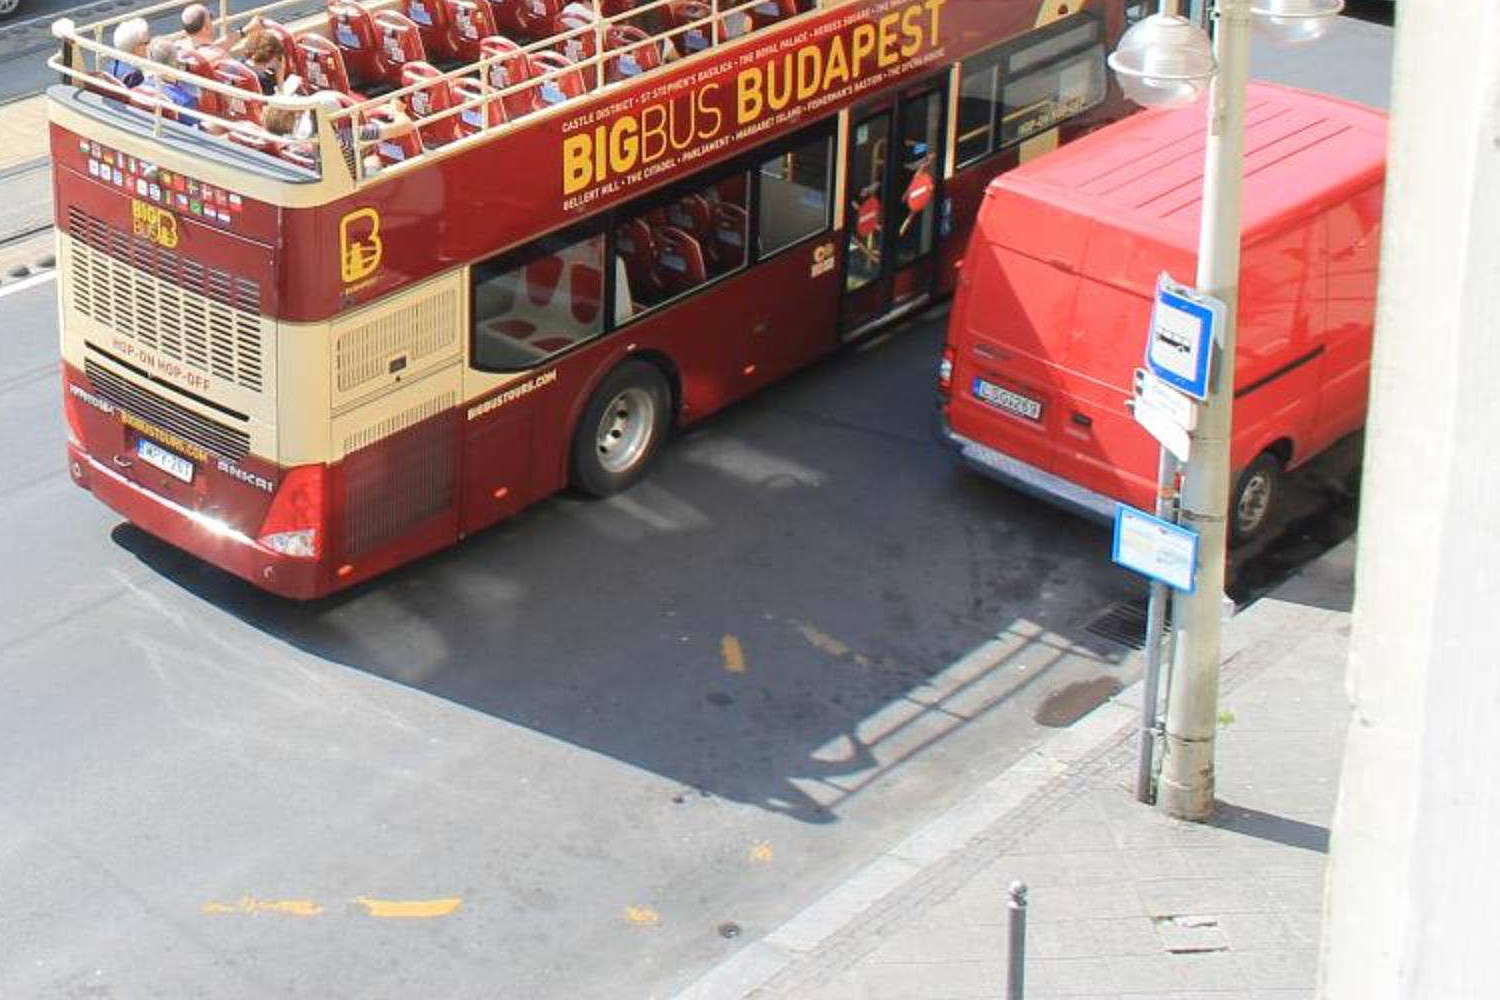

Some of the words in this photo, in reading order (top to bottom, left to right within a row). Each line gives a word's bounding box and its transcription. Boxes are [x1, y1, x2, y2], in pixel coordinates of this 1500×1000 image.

[562, 114, 595, 133] CASTLE
[596, 97, 633, 120] DISTRICT
[697, 61, 732, 82] BASILICA
[739, 51, 754, 65] THE
[755, 43, 778, 59] ROYAL
[779, 31, 808, 49] PALACE
[563, 187, 599, 211] GELLERT
[602, 180, 620, 197] HILL
[627, 173, 642, 185] THE
[644, 157, 676, 180] CITADEL
[682, 137, 729, 162] PARLIAMENT
[808, 86, 853, 112] FISHERMAN'S
[854, 73, 883, 92] BASTION
[132, 199, 157, 225] BIG
